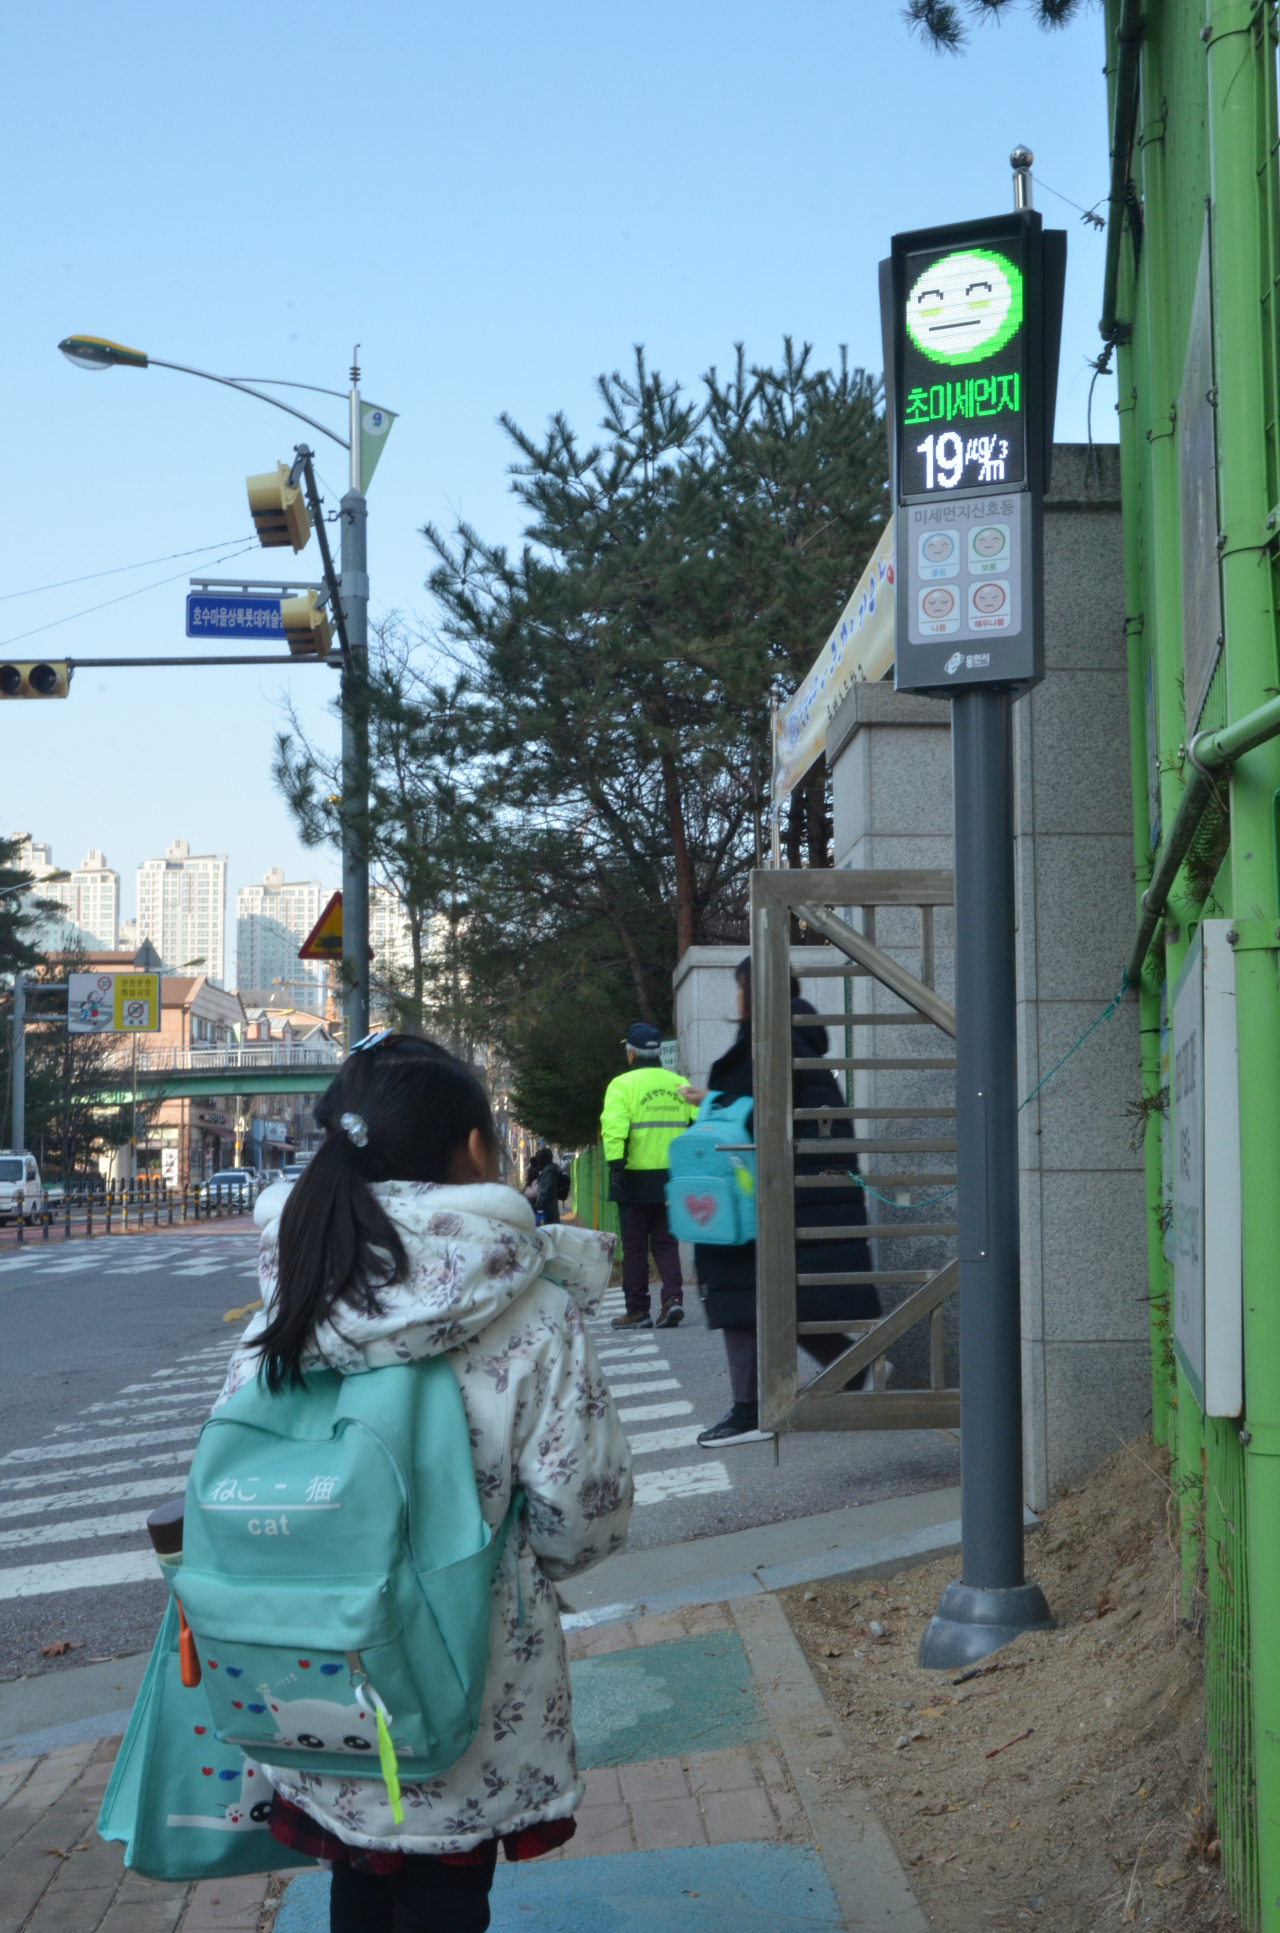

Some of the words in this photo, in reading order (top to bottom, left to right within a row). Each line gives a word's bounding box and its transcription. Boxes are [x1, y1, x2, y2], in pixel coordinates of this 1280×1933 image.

[904, 372, 1020, 425] 초미세먼지
[917, 431, 963, 488] 19
[914, 499, 1015, 525] 미세먼지신호등
[192, 606, 284, 629] 호수마을상록롯데캐슬
[965, 653, 990, 669] 용인시
[122, 979, 151, 987] 안전운전
[122, 989, 151, 997] 하십시오
[209, 1476, 260, 1501] ねこ
[305, 1474, 340, 1503] 猫
[247, 1513, 291, 1536] cat
